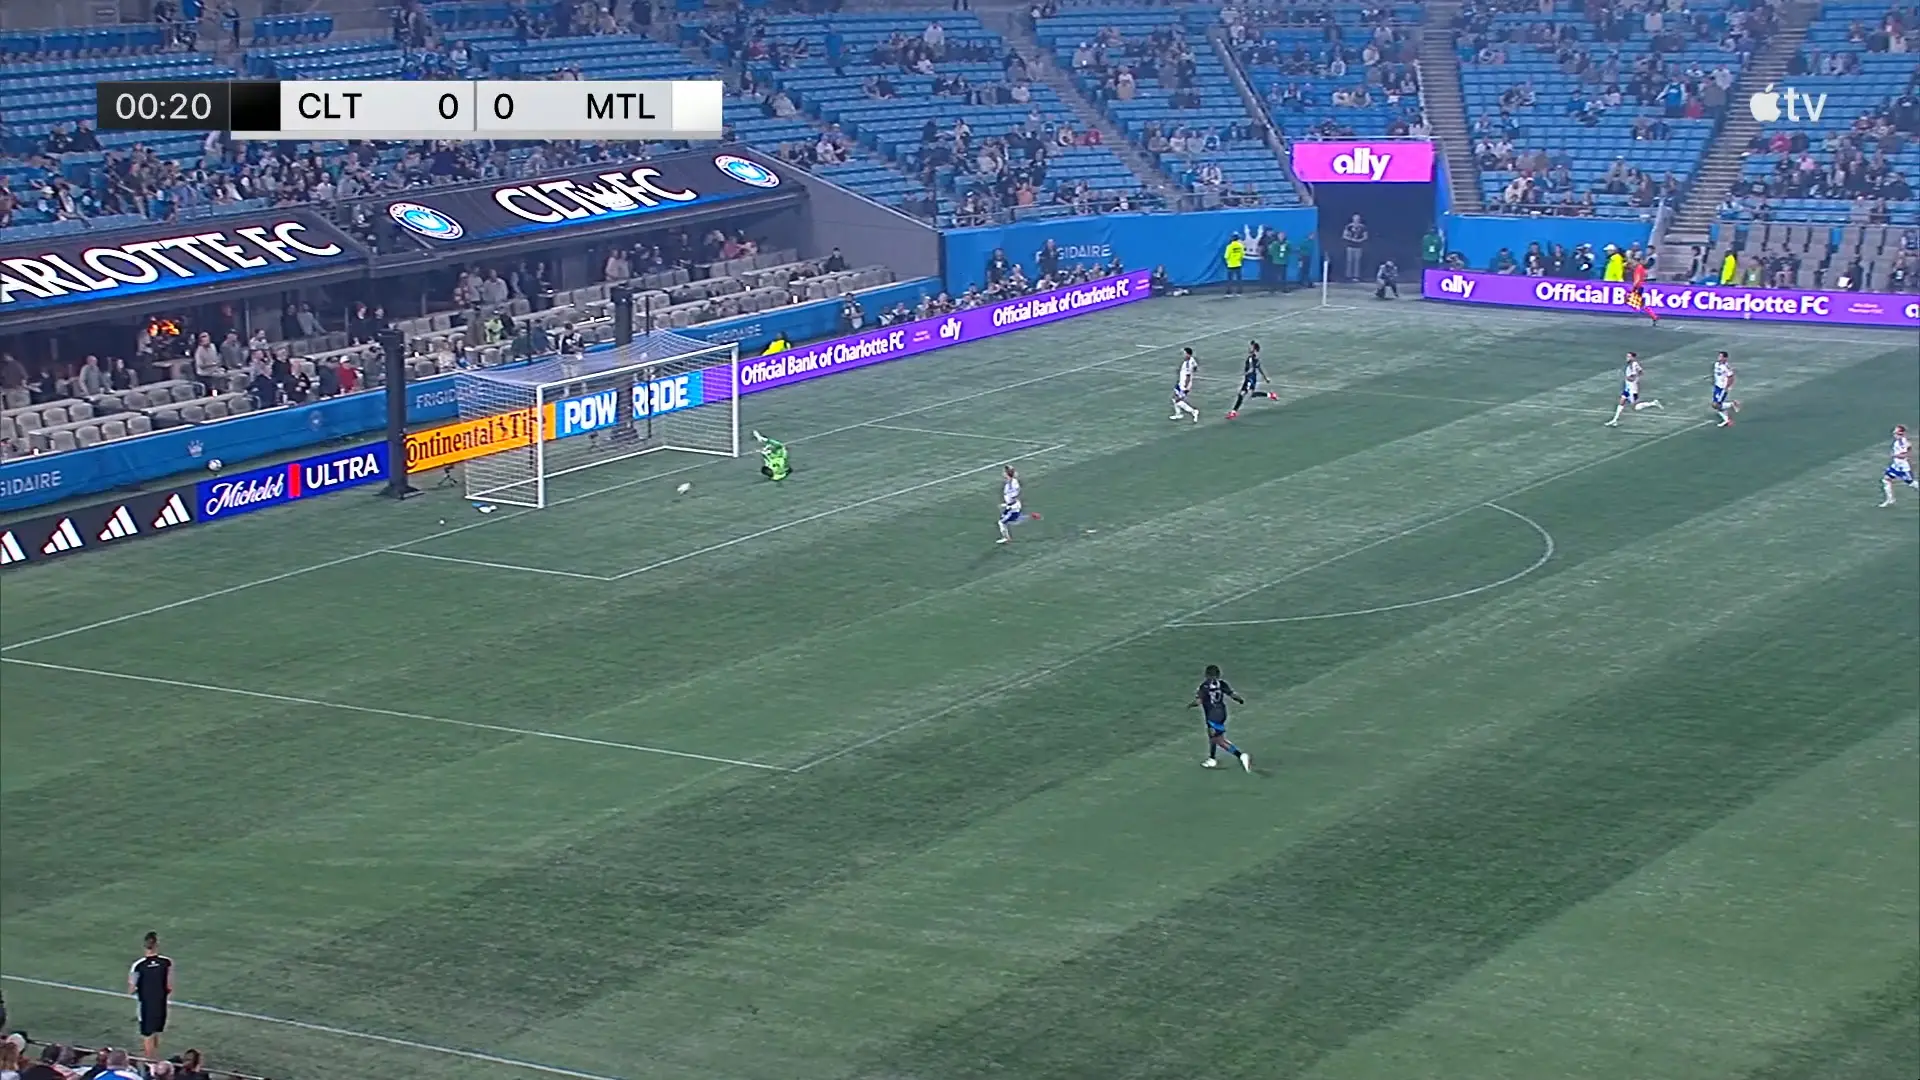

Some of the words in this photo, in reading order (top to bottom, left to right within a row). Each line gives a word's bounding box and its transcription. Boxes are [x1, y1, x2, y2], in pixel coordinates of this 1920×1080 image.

[1333, 147, 1391, 180] ally
[495, 179, 609, 223] CLT
[599, 168, 697, 208] FC
[236, 222, 342, 262] FC
[992, 305, 1031, 327] Official
[1032, 296, 1058, 316] Bank
[1059, 292, 1071, 311] of
[1071, 285, 1116, 309] Charlotte
[1116, 278, 1130, 299] FC
[1440, 274, 1475, 298] ally
[1535, 281, 1609, 305] Official
[1612, 287, 1664, 308] Bnk
[1666, 288, 1692, 309] of
[1693, 291, 1797, 314] Charlotte
[1800, 295, 1829, 315] FC
[939, 317, 962, 340] ally
[741, 357, 786, 386] Official
[787, 354, 819, 376] Bank
[819, 346, 834, 367] of
[833, 338, 889, 364] Charlotte
[889, 330, 905, 352] FC
[564, 376, 689, 434] POWRADE
[205, 473, 285, 516] Michelob
[306, 453, 380, 489] ULTRA
